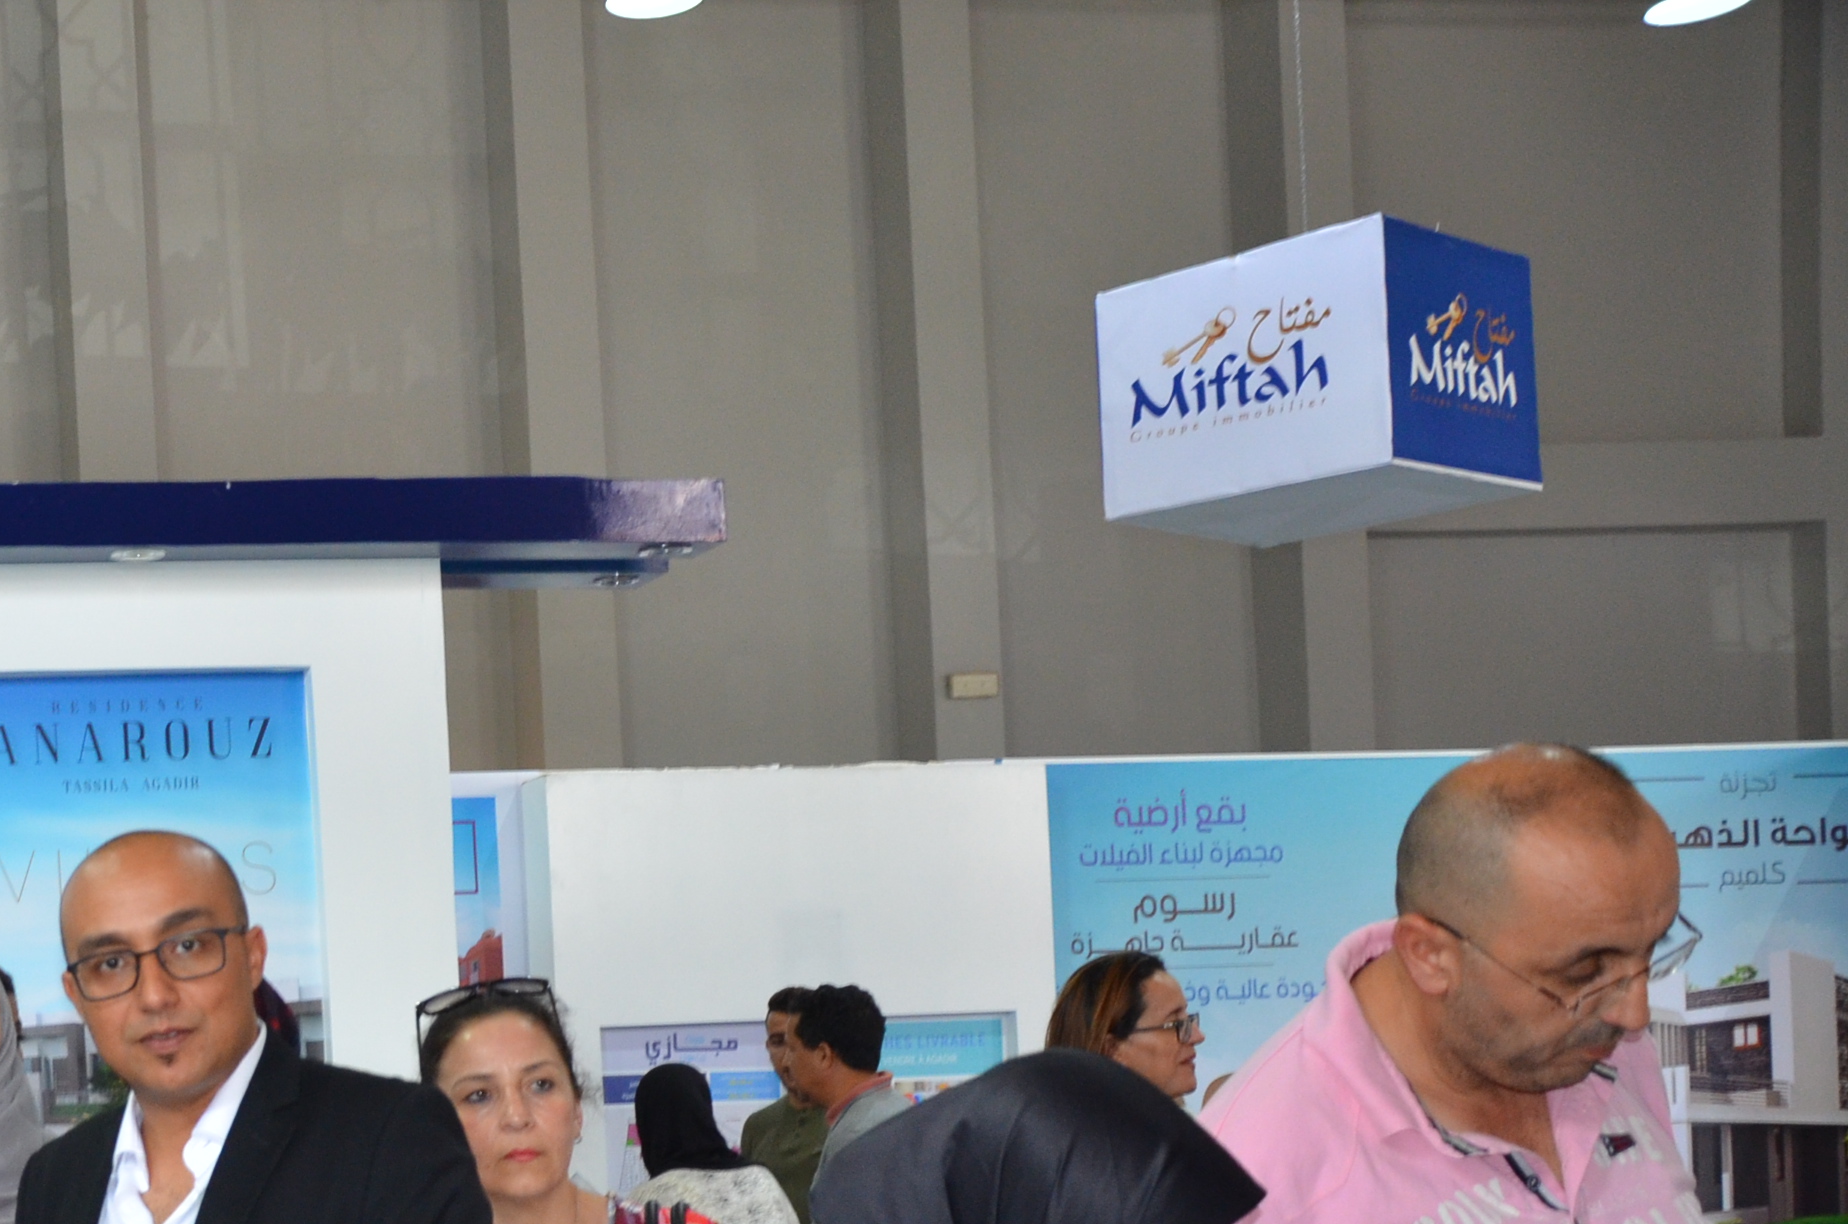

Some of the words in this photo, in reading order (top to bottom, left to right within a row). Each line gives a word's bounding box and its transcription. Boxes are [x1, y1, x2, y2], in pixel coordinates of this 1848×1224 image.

[1131, 338, 1329, 428] Miftah
[1409, 333, 1518, 408] Miftah
[1129, 422, 1201, 444] Groupe
[1212, 396, 1327, 427] immobilier
[51, 697, 203, 715] RESIDENCE
[62, 776, 130, 794] TASSILA
[142, 774, 201, 791] AGADIR
[1113, 788, 1187, 835] أرضية
[1195, 796, 1246, 833] بقع
[1079, 842, 1154, 871] الفيلات
[1158, 841, 1205, 869] لبناء
[1209, 840, 1284, 868] مجهزة
[1718, 860, 1786, 892] كلميم
[1133, 891, 1236, 923] رسوم
[1170, 926, 1299, 954] عقارية
[1216, 976, 1271, 1006] عالية
